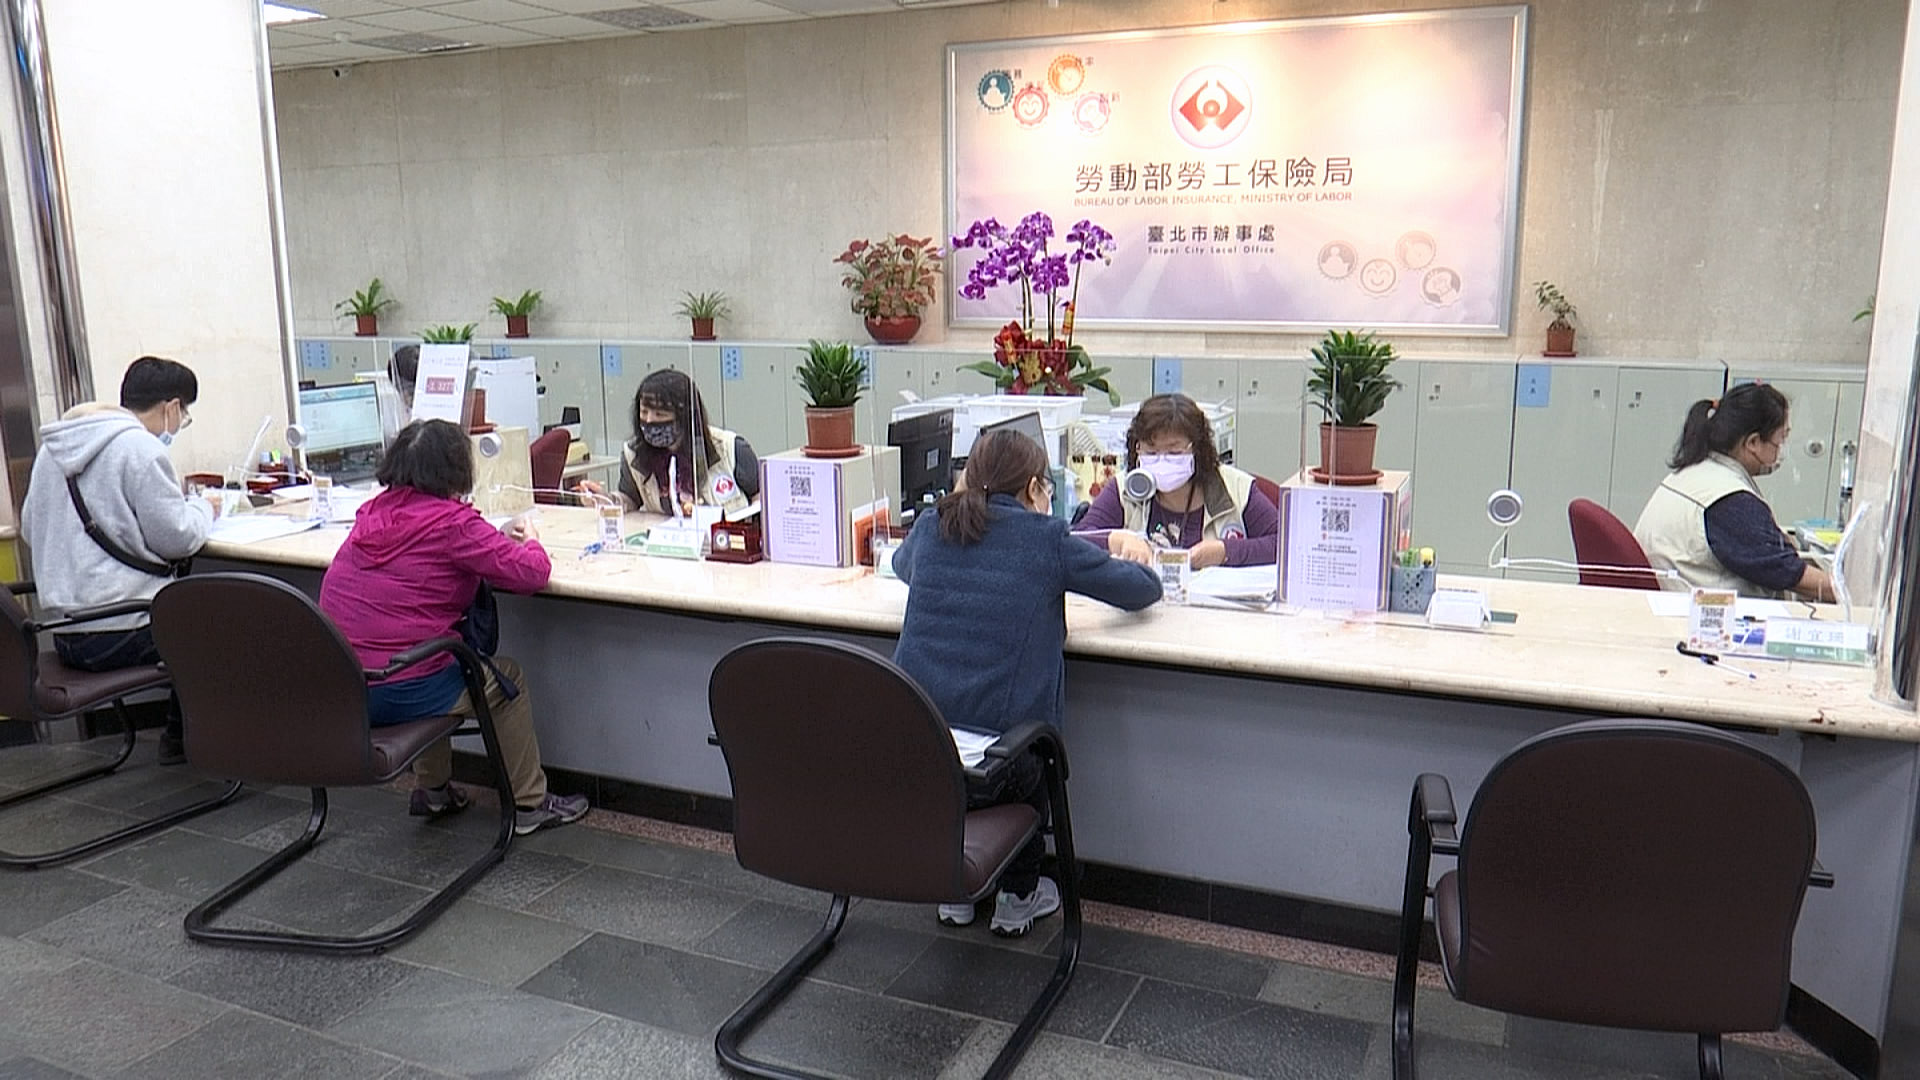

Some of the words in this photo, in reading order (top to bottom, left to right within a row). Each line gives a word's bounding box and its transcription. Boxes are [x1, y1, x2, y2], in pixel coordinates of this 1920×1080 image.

[1075, 156, 1353, 193] 勞動部勞工保險局
[1074, 197, 1114, 207] BUREAU
[1116, 196, 1129, 206] OF
[1134, 195, 1168, 206] LABOR
[1241, 193, 1294, 204] MINISTRY
[1296, 192, 1314, 202] OF
[1316, 191, 1352, 201] LABOR
[1147, 224, 1275, 242] 臺北市辦事處
[1147, 246, 1179, 255] Taipei
[1184, 246, 1205, 255] City
[1210, 246, 1238, 254] Local
[1243, 245, 1275, 254] Office
